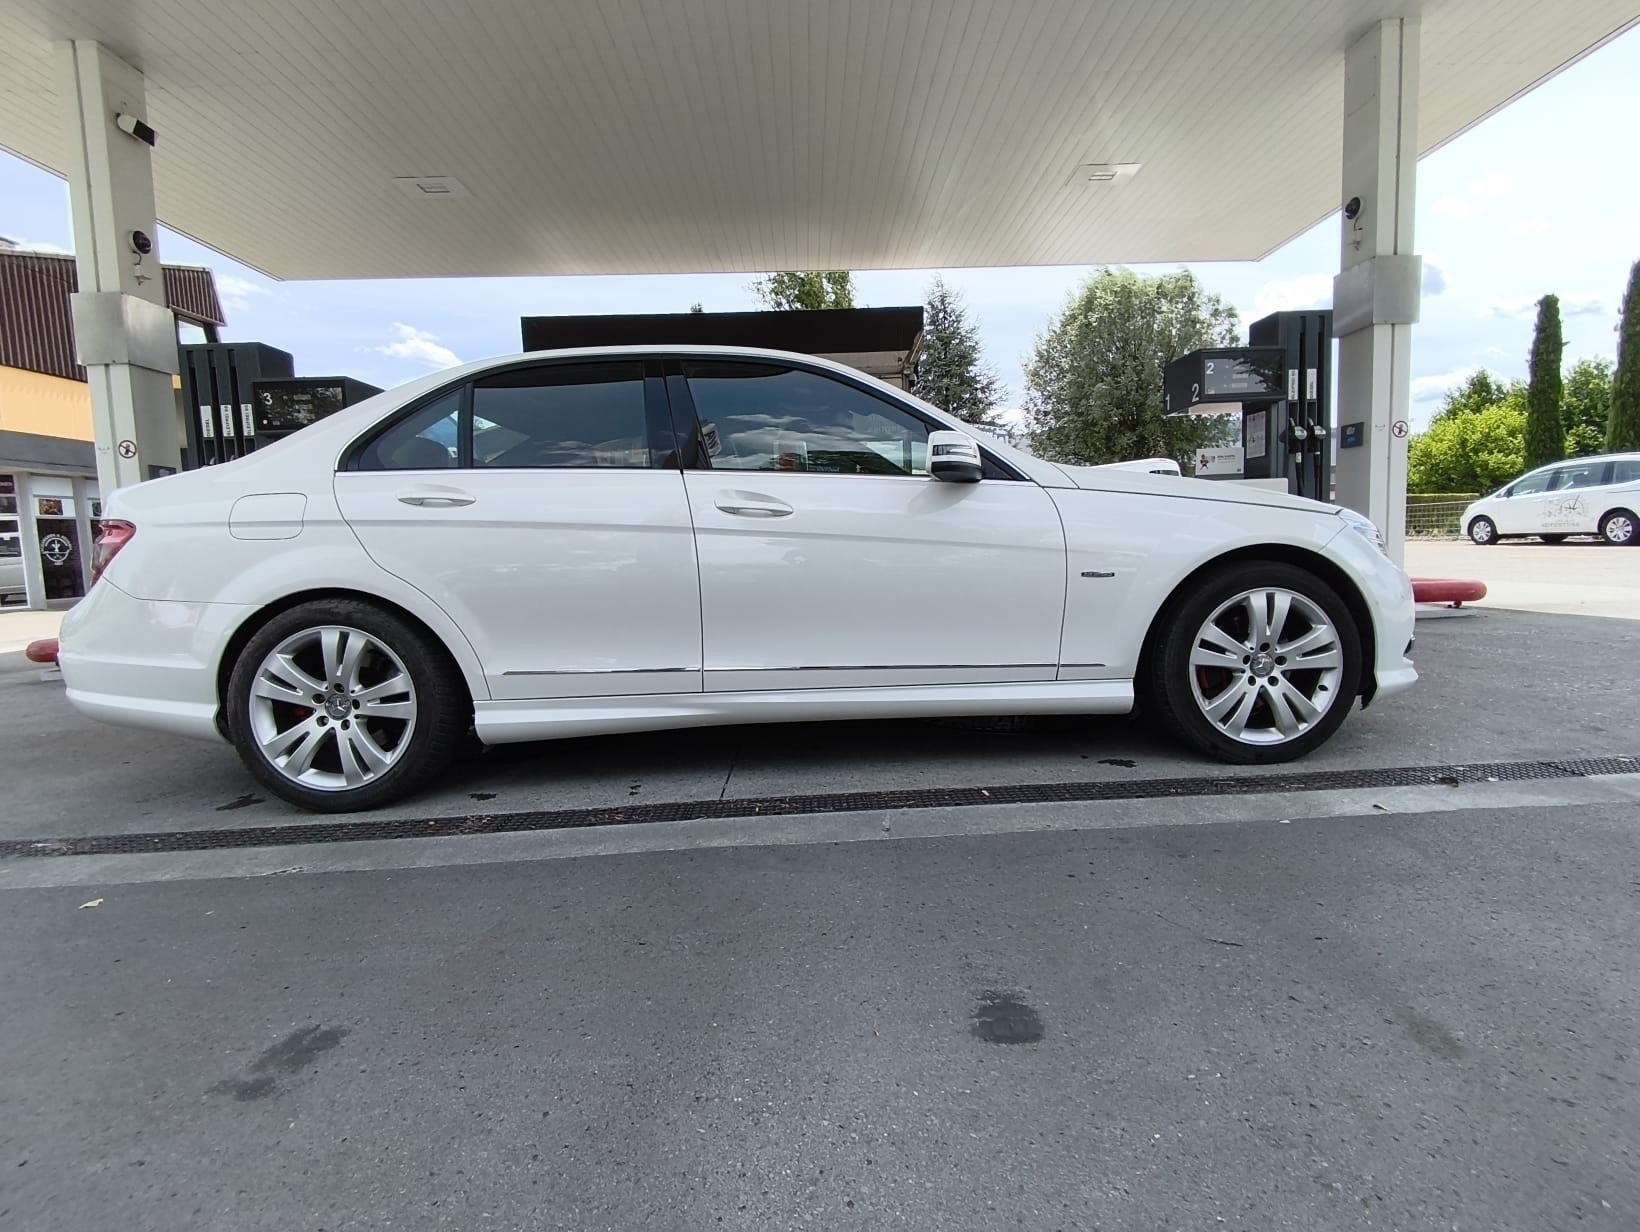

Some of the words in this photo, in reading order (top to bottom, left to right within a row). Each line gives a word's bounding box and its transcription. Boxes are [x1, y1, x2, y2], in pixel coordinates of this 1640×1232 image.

[1206, 362, 1214, 374] 2
[263, 392, 272, 405] 3
[1191, 383, 1199, 402] 2
[1165, 393, 1170, 410] 1
